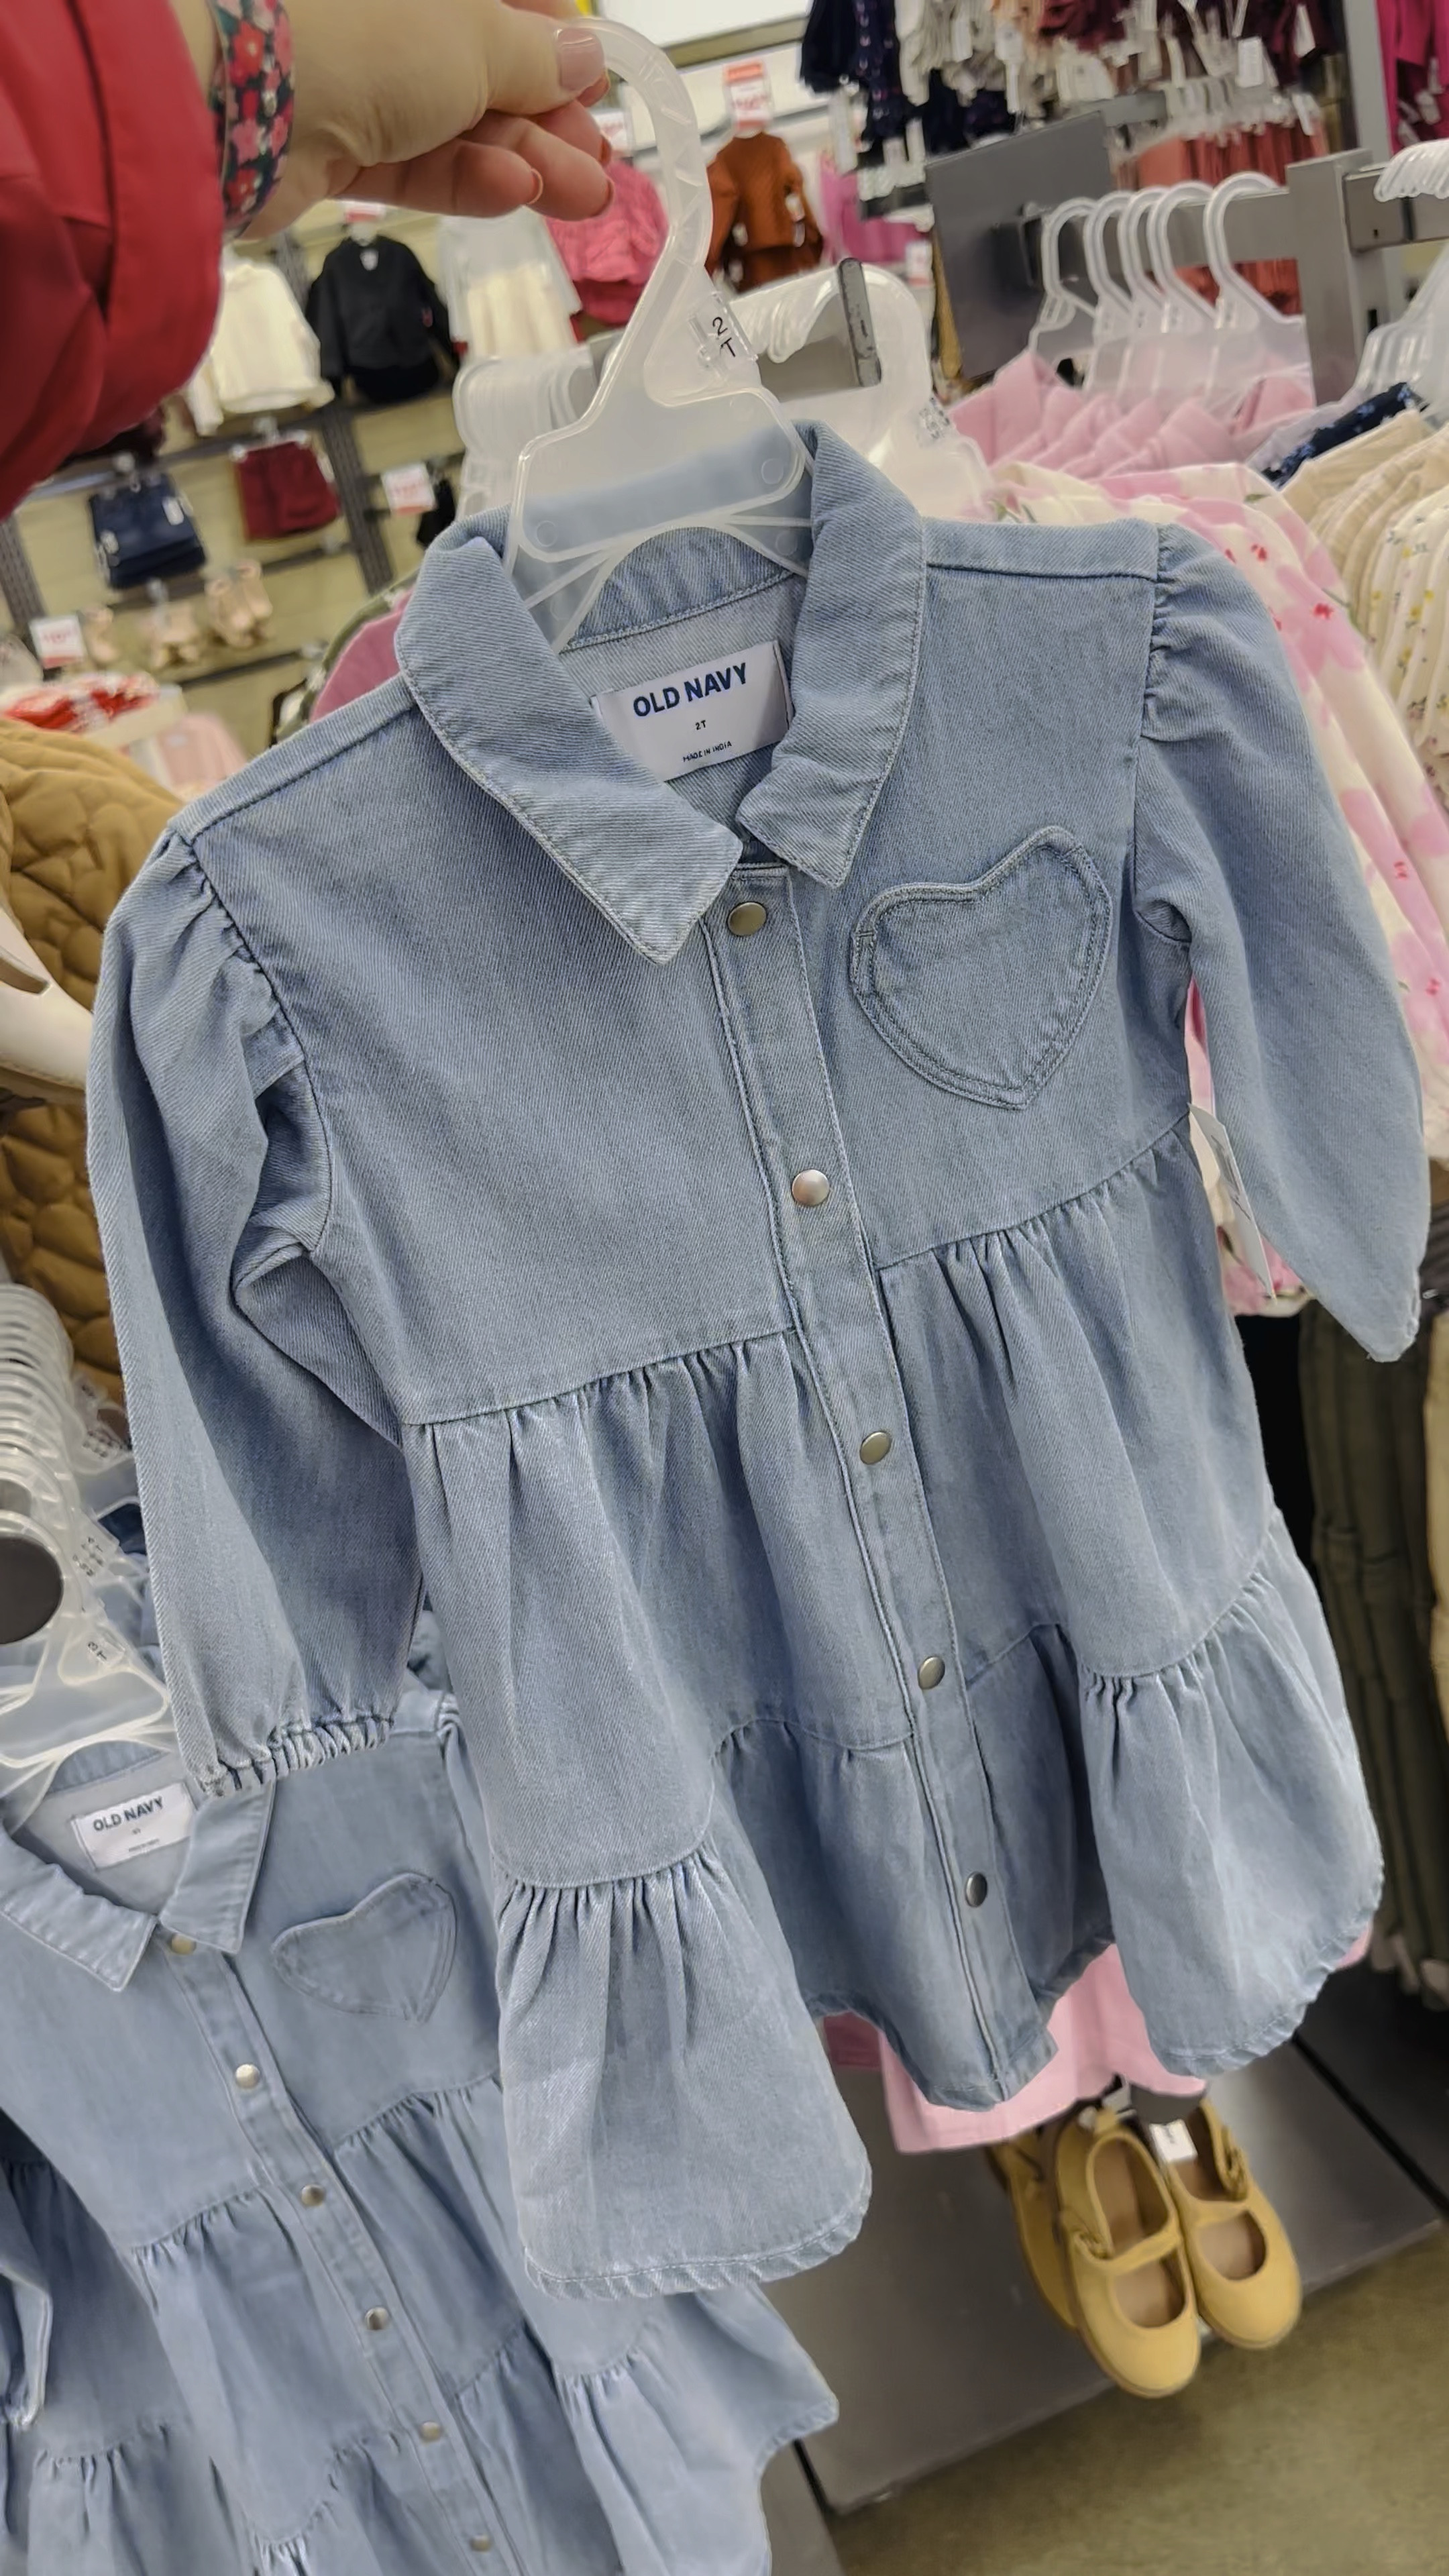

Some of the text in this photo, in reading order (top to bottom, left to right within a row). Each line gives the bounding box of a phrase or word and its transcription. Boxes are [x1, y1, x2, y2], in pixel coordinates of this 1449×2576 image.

[633, 662, 746, 717] OLD NAVY
[695, 720, 706, 731] 2T
[683, 741, 732, 762] MADE IN INDIA
[93, 1796, 163, 1831] OLD NAVY
